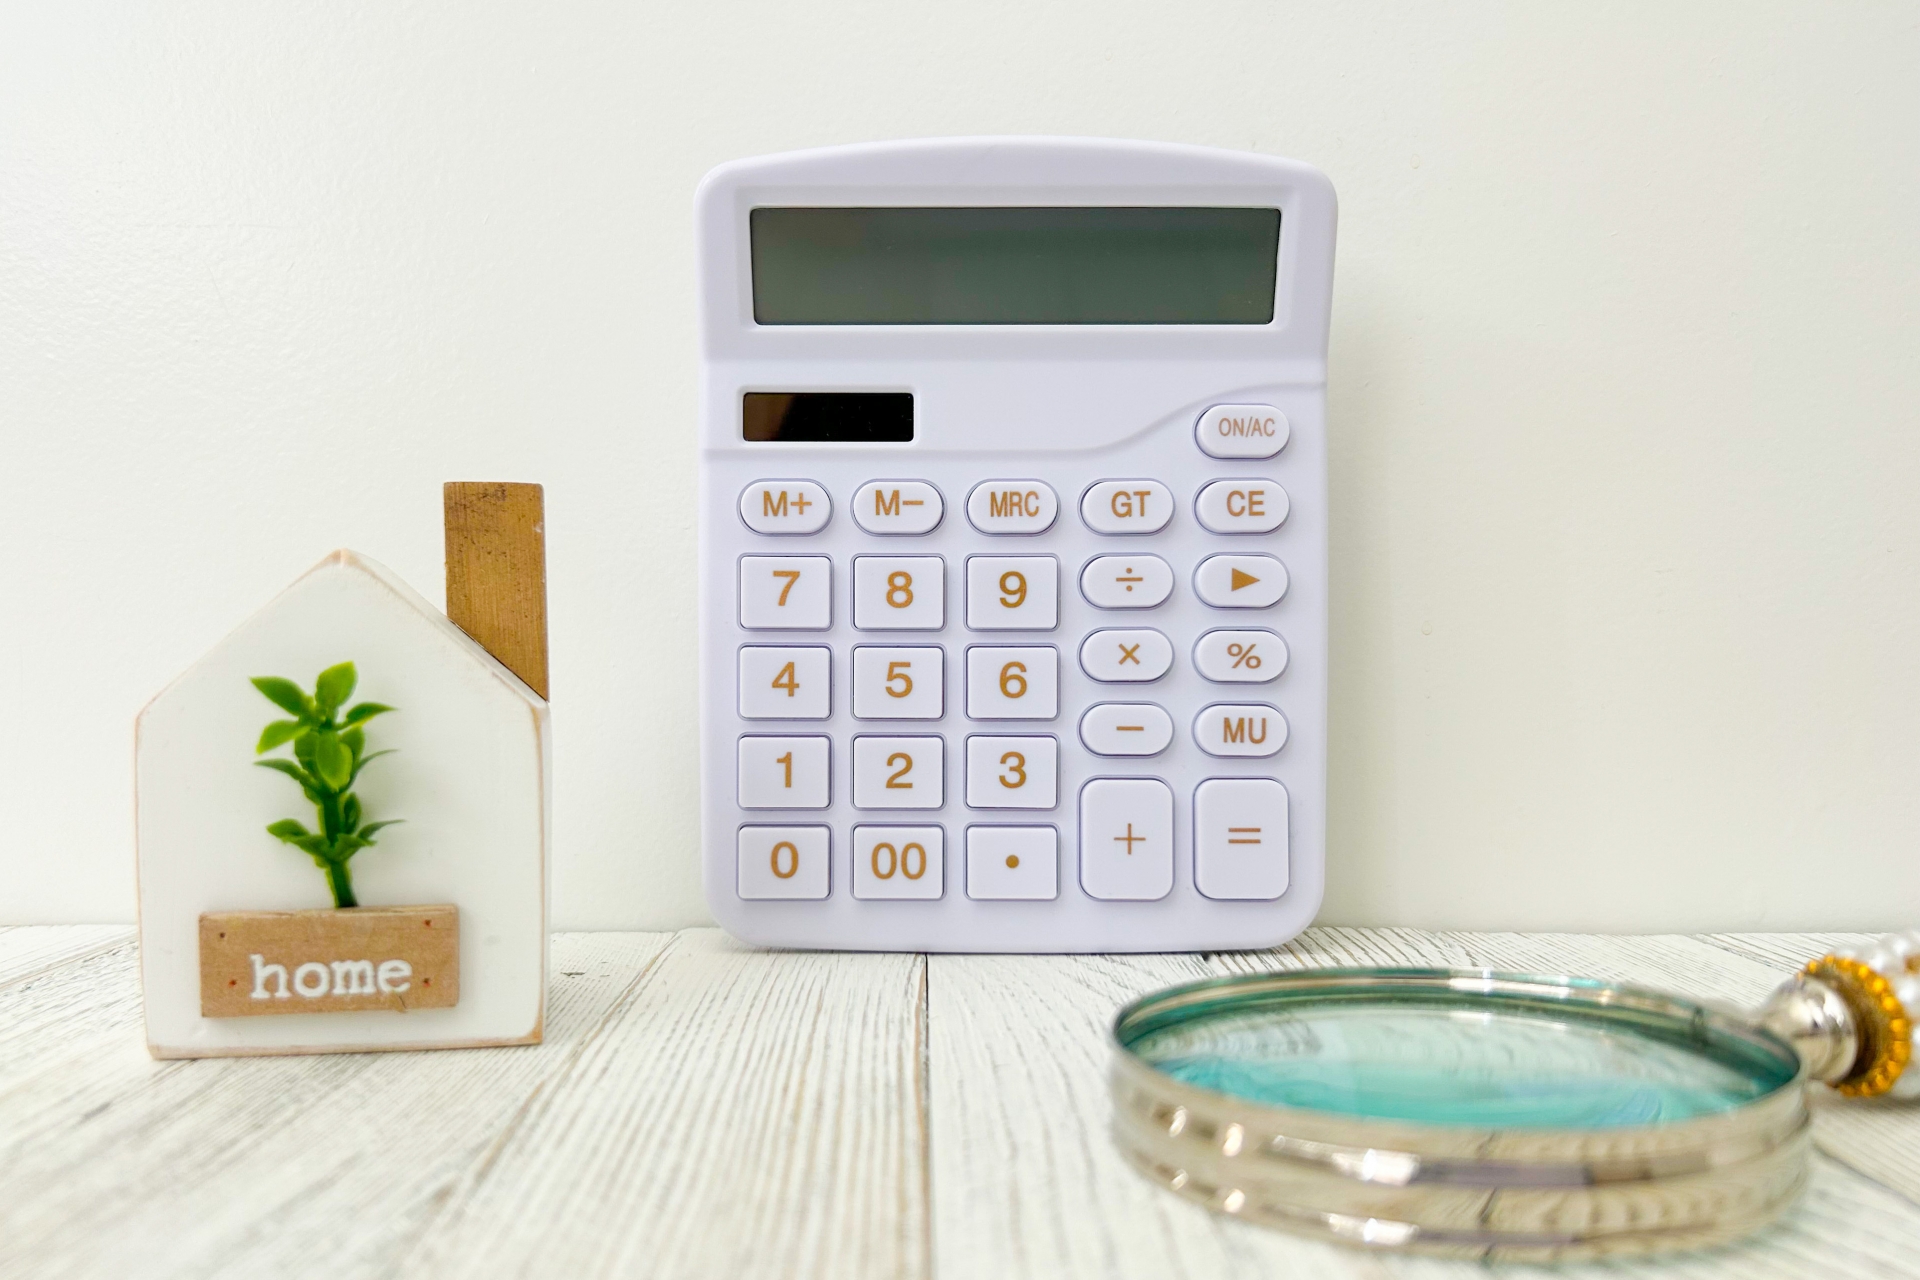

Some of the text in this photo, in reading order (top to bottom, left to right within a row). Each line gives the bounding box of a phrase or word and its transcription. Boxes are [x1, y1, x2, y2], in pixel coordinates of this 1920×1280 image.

[1218, 418, 1276, 438] ON/AC
[762, 490, 813, 517] M+
[990, 490, 1040, 517] MRC
[1111, 490, 1151, 518] GT
[1226, 489, 1266, 517] CE
[772, 570, 801, 607] 7
[885, 570, 914, 609] 8
[998, 570, 1028, 609] 9
[771, 661, 800, 697] 4
[885, 661, 914, 699] 5
[998, 661, 1028, 699] 6
[1223, 717, 1267, 744] MU
[776, 751, 793, 789] 1
[885, 751, 914, 789] 2
[998, 751, 1027, 789] 3
[770, 841, 799, 879] 0
[871, 842, 927, 881] 00
[249, 952, 413, 999] home
